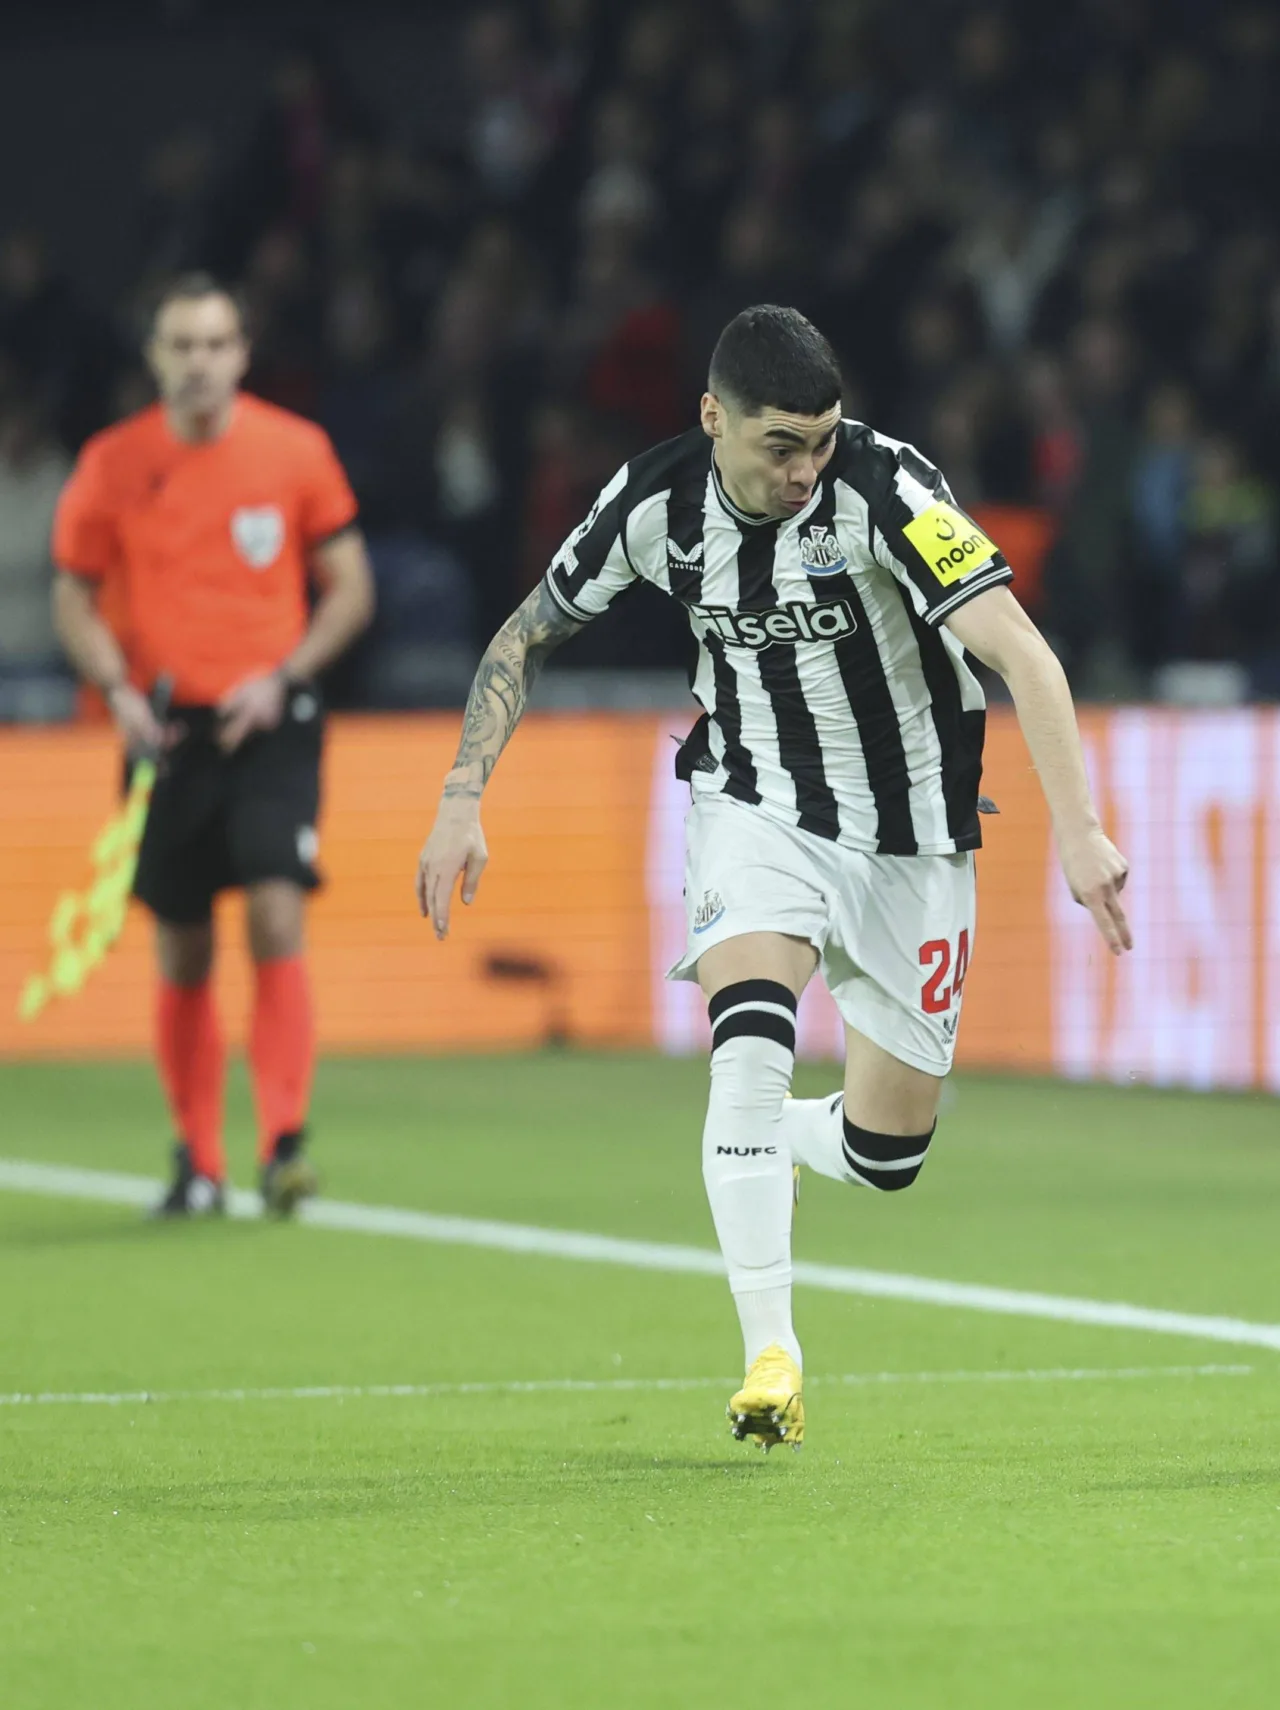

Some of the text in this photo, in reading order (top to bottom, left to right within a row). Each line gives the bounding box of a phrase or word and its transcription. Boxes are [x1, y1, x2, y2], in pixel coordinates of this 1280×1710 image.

[935, 534, 986, 575] noon
[919, 927, 968, 1014] 24
[716, 1145, 777, 1156] NUFC
